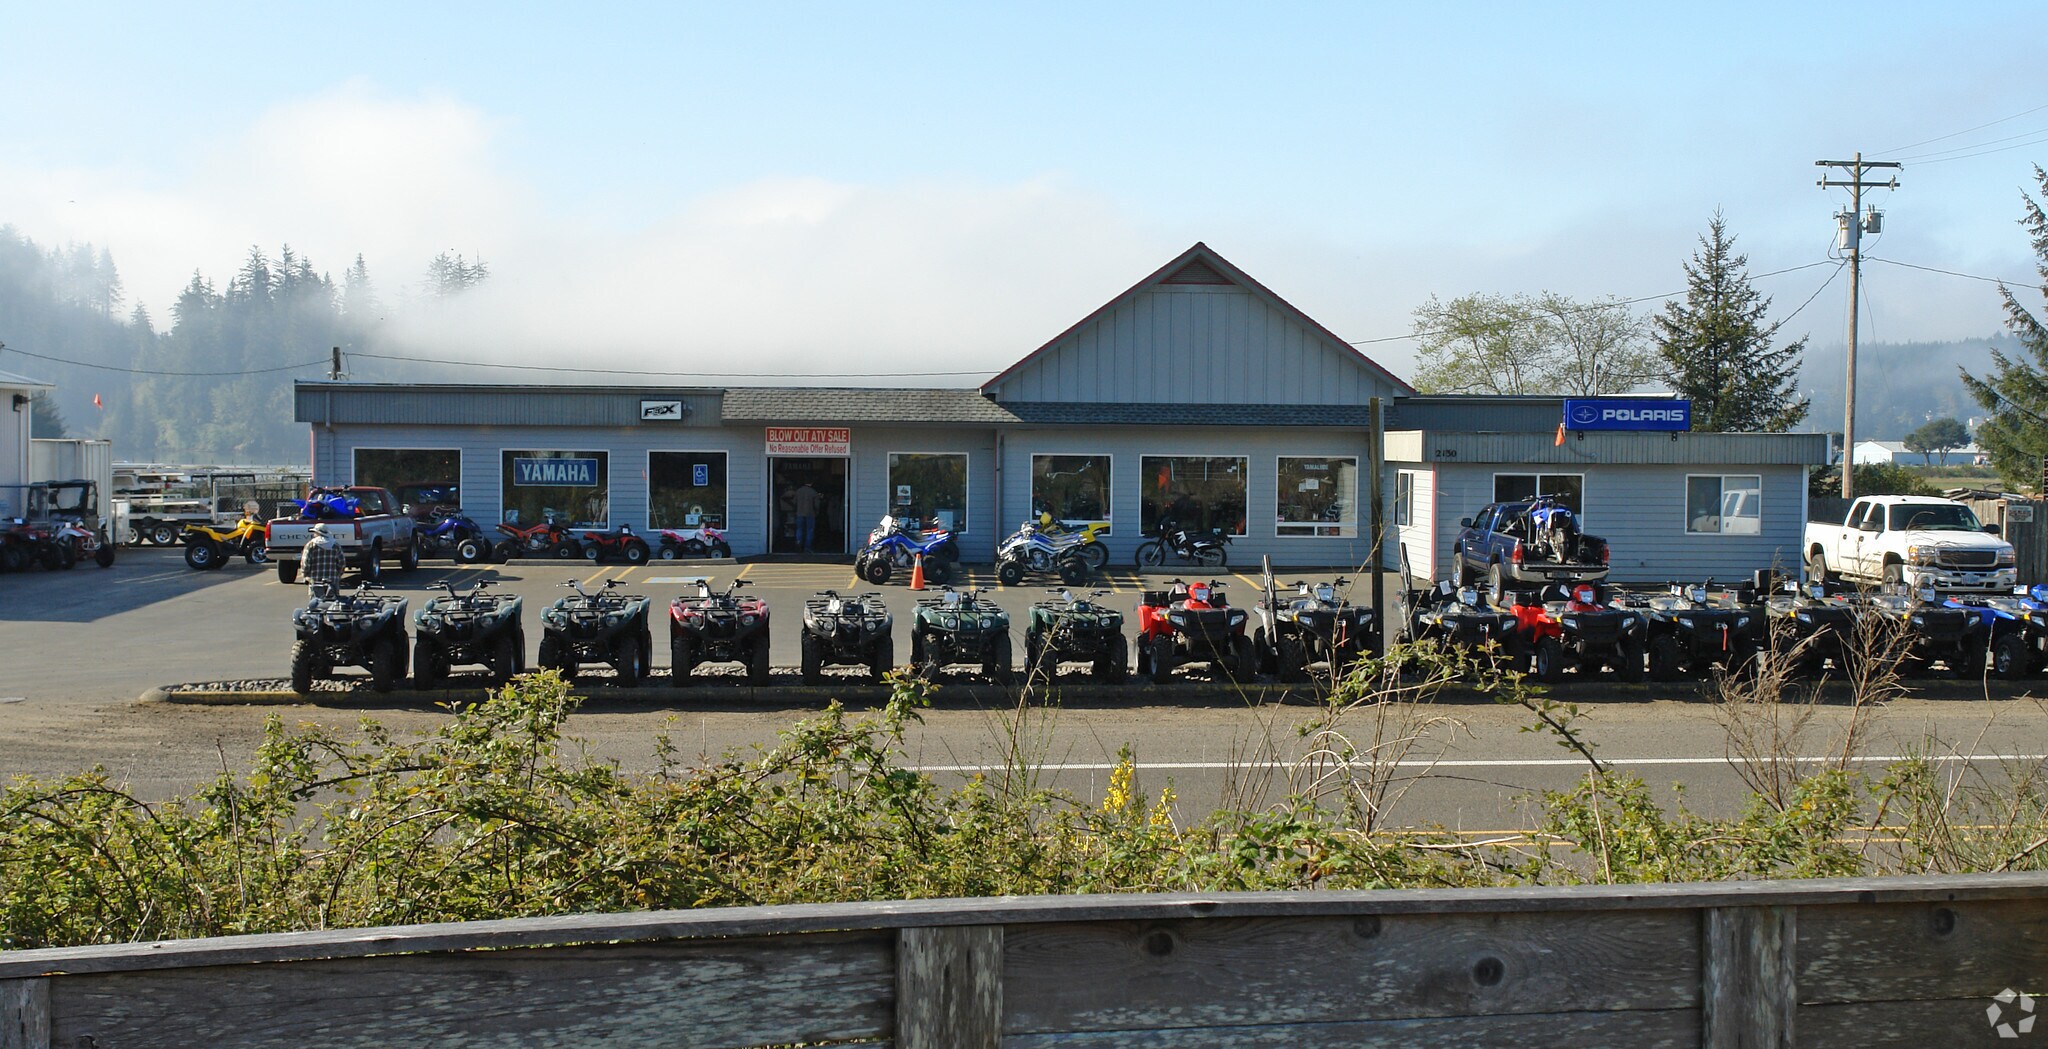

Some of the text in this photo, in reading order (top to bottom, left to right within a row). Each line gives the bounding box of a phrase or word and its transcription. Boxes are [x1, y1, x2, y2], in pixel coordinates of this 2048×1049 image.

[1602, 409, 1684, 421] POLARIS
[769, 430, 847, 442] BLOW OUT ATV SALE
[769, 444, 847, 453] No Reasonable Offer Refused
[521, 464, 590, 481] YAMAHA
